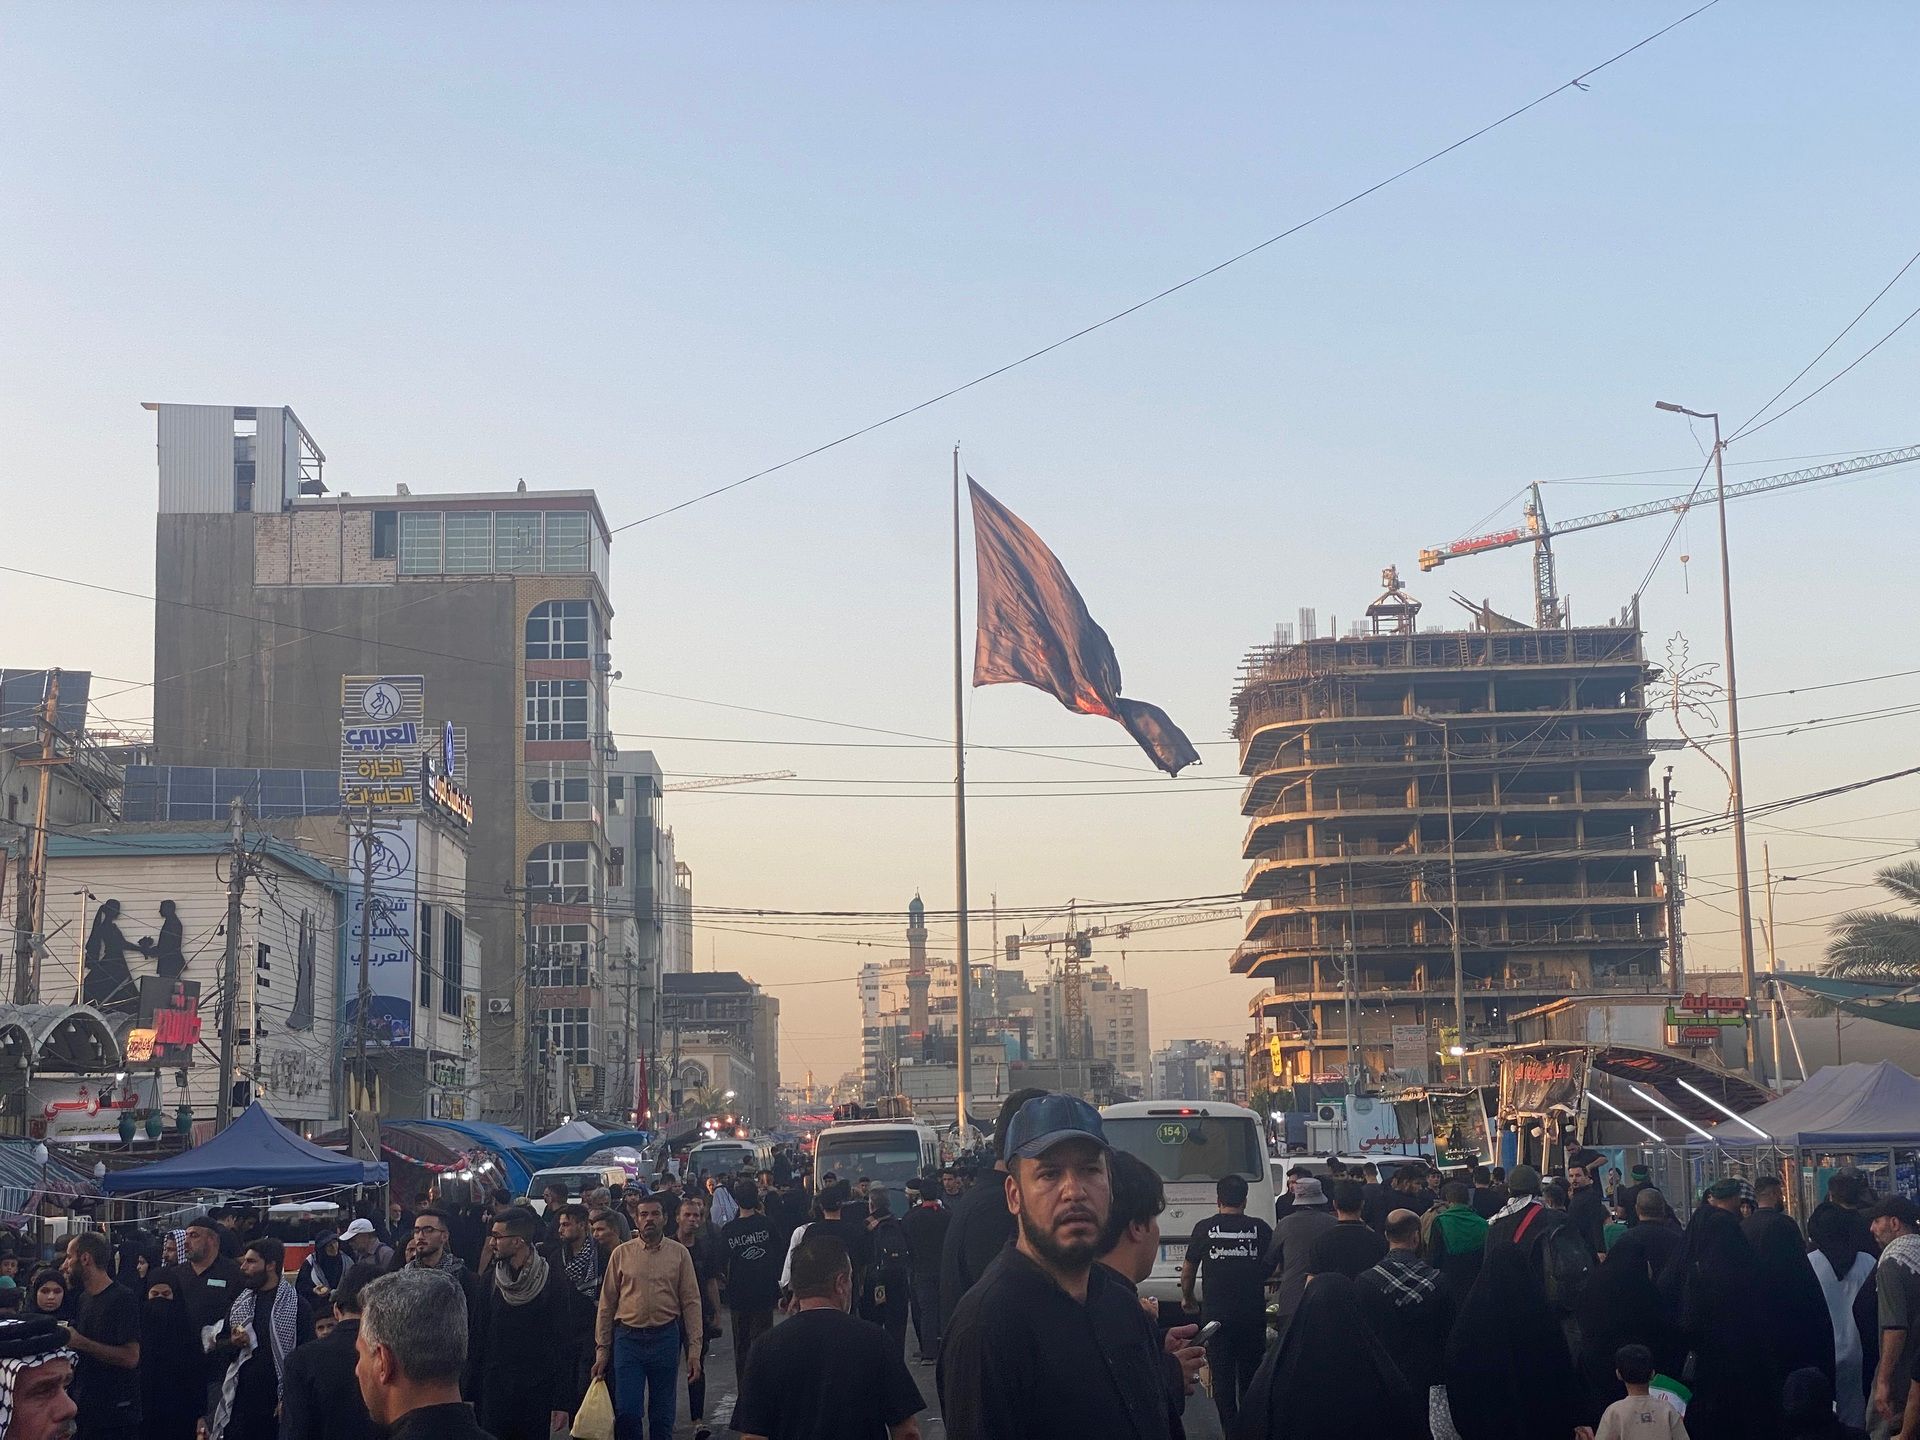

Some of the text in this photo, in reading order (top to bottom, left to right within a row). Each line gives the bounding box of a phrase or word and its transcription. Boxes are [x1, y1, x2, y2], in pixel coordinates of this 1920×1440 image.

[345, 722, 418, 751] العربي
[355, 899, 408, 914] شة
[351, 949, 409, 967] العربي
[1682, 993, 1746, 1014] صيدلية
[1163, 1126, 1181, 1136] 154
[1208, 1225, 1258, 1242] لبيك
